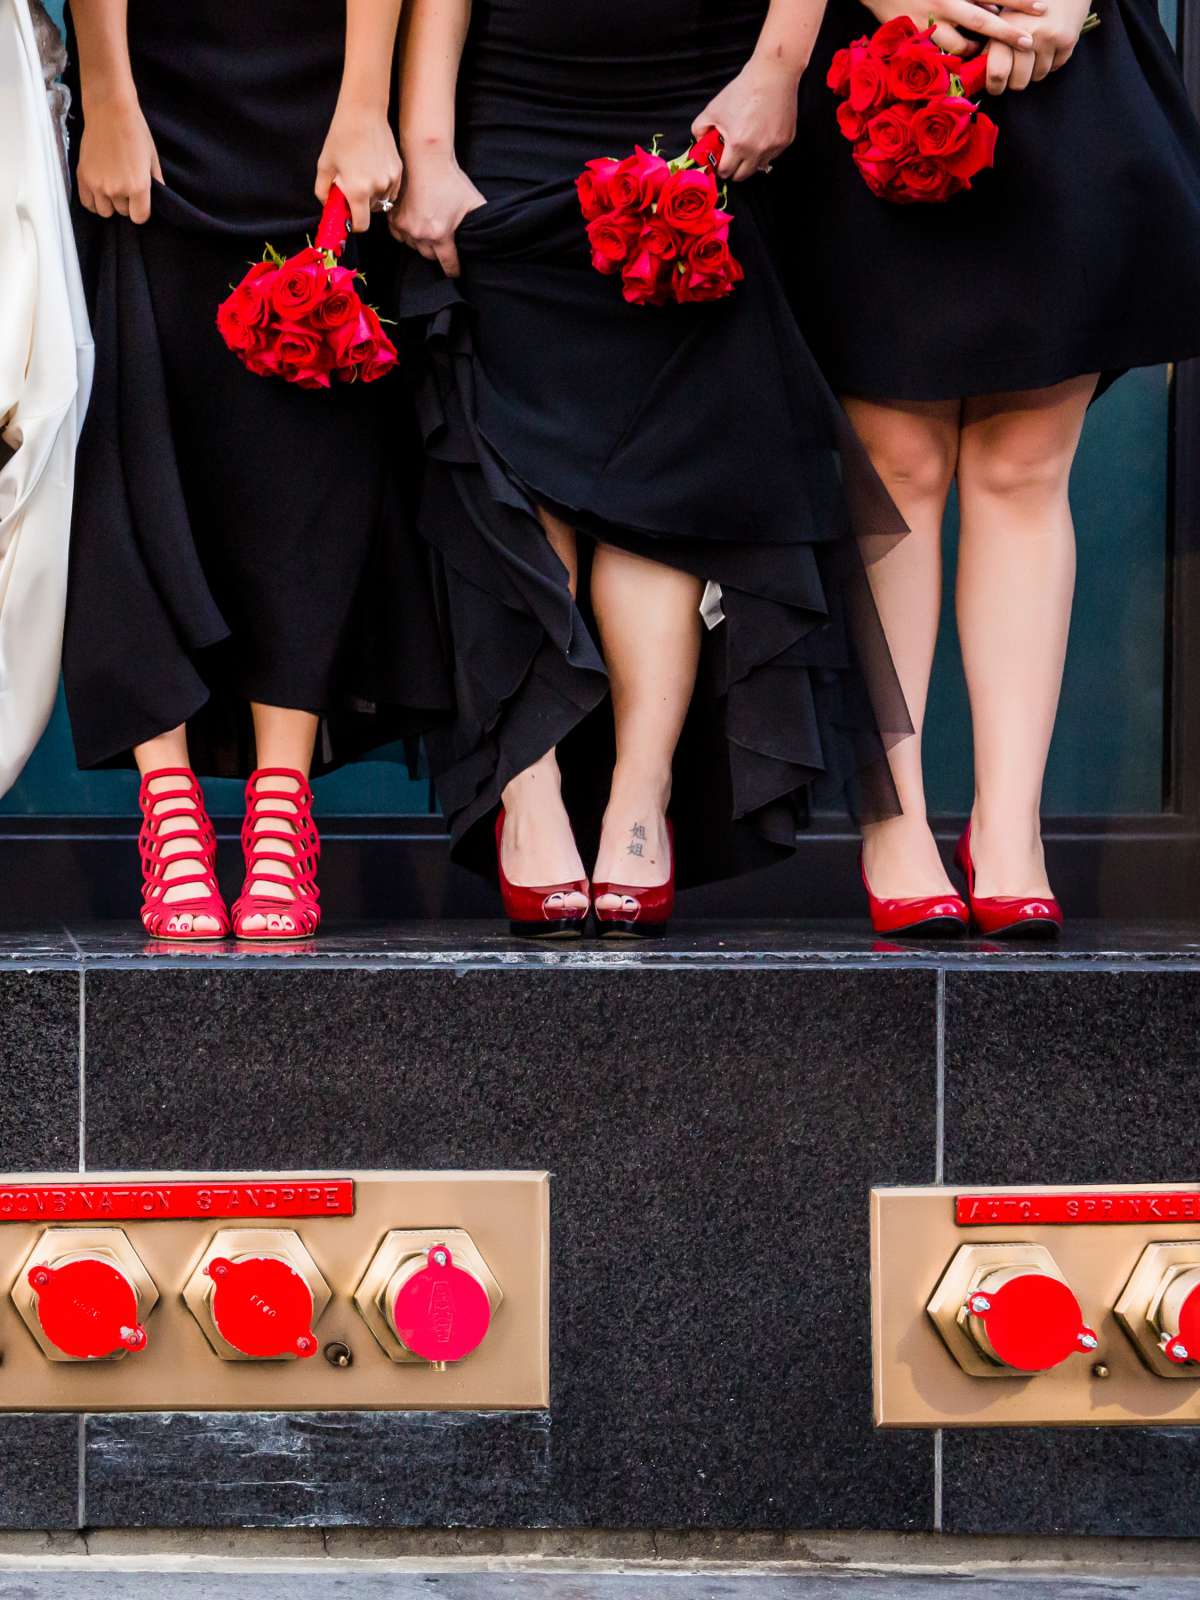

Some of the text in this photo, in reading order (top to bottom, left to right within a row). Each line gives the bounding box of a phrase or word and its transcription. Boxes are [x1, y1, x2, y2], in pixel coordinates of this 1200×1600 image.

[0, 1187, 340, 1212] COMBINATION STANDPIPE
[1066, 1198, 1200, 1217] SPRINKLE
